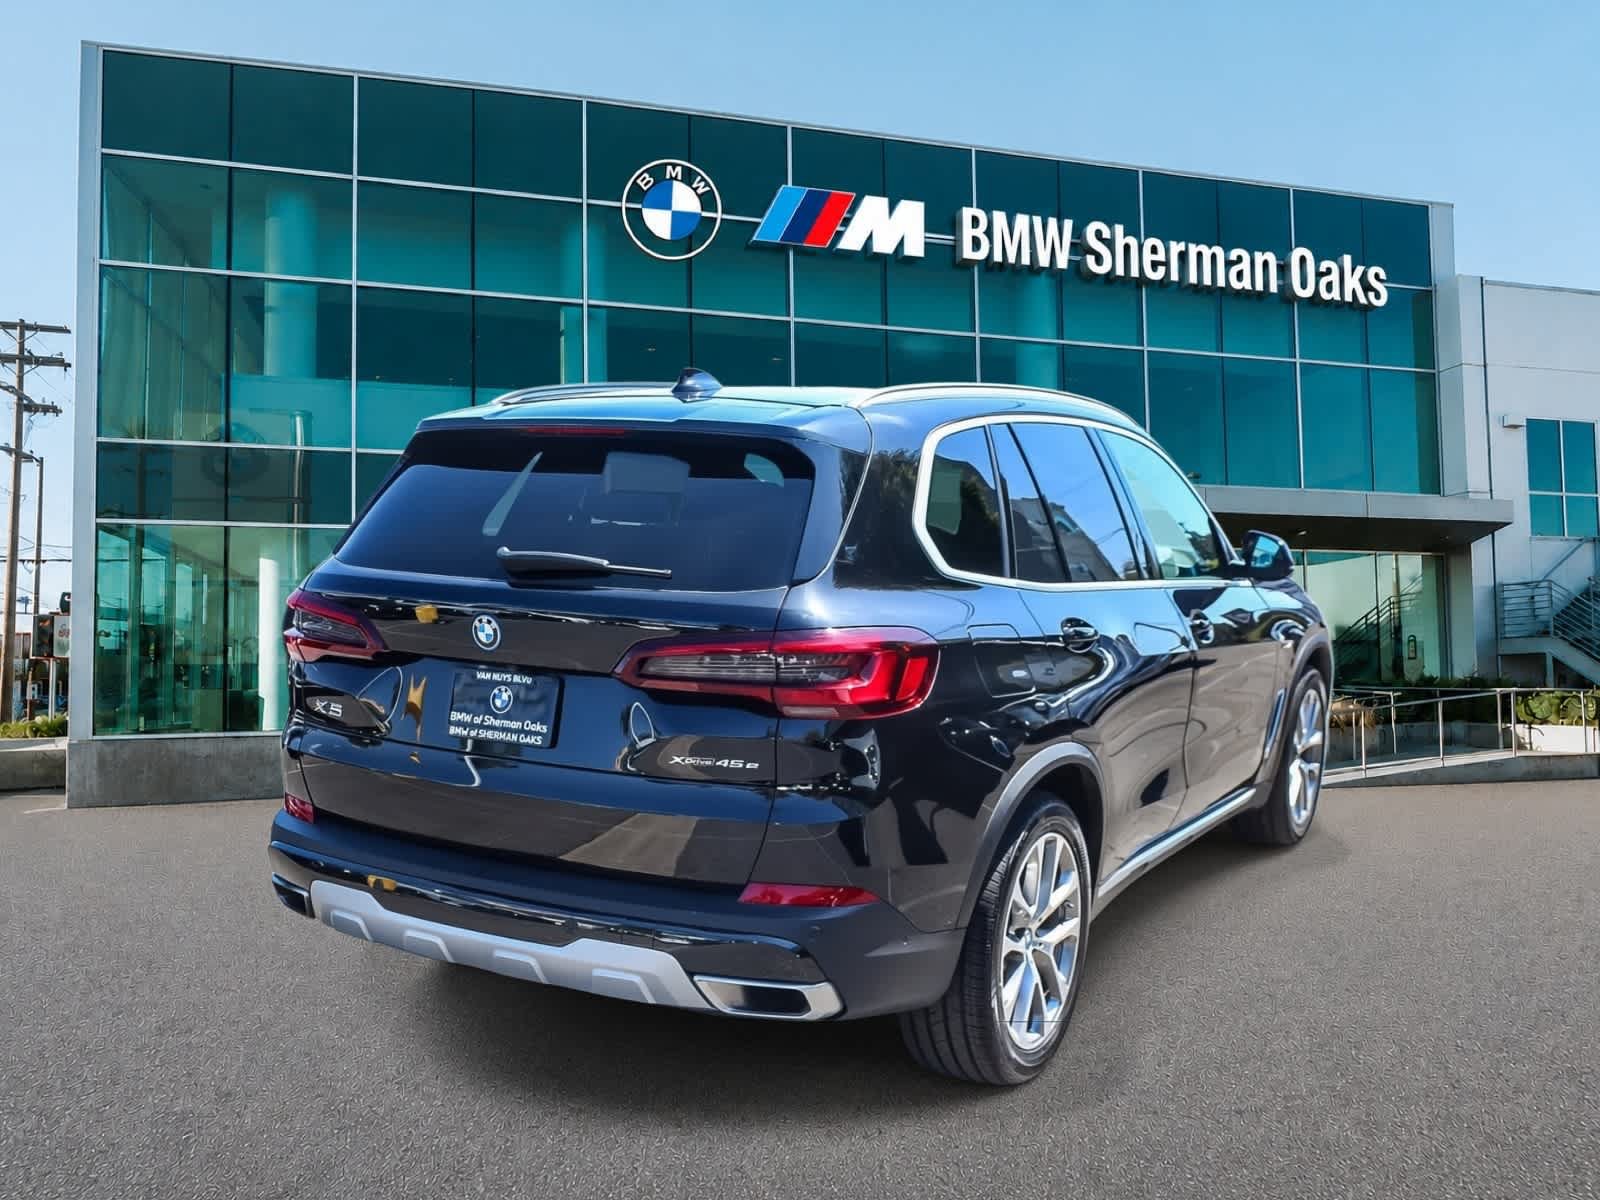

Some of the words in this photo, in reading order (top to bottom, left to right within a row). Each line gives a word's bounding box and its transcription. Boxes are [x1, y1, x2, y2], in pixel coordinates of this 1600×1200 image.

[635, 165, 711, 195] BMW
[835, 195, 925, 257] M
[961, 206, 1073, 269] BMW
[1085, 221, 1278, 293] Sherman
[1291, 247, 1388, 307] Oaks
[476, 671, 491, 680] VAN
[492, 673, 511, 682] NUYS
[313, 699, 343, 718] X5
[450, 711, 473, 723] BMW
[473, 715, 483, 725] of
[483, 715, 522, 730] Sherman
[523, 720, 548, 734] Oaks
[448, 725, 469, 737] BMW
[469, 729, 478, 737] of
[478, 730, 517, 743] SHERMAN
[519, 733, 543, 745] OAKS
